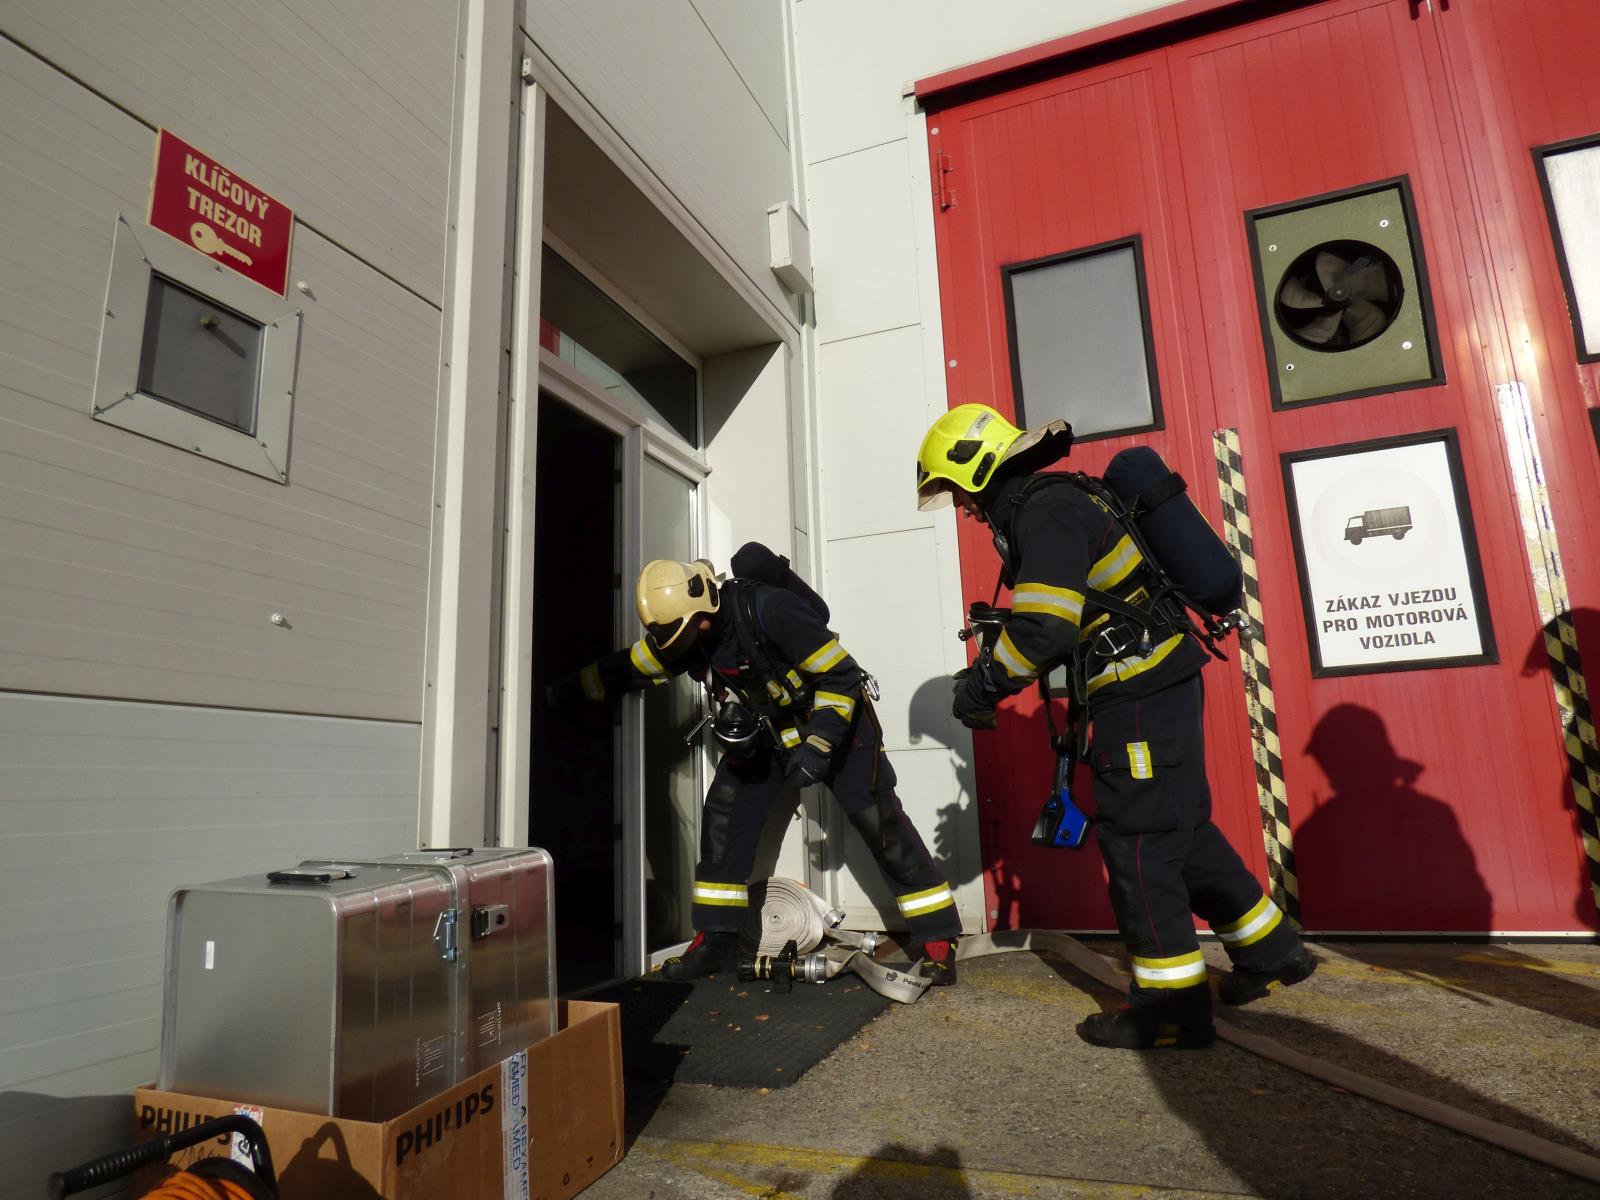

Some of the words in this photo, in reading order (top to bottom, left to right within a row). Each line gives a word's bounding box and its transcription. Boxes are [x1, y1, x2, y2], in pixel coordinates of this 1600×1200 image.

[185, 154, 270, 220] KLÍČOVÝ
[187, 186, 262, 248] TREZOR
[1322, 617, 1358, 633] PRO
[1366, 603, 1468, 629] MOTOROVÁ
[1325, 595, 1382, 613] ZÁKAZ
[1388, 587, 1457, 606] VJEZDU
[1359, 630, 1436, 650] VOZIDLA
[396, 1083, 494, 1167] PHILIPS
